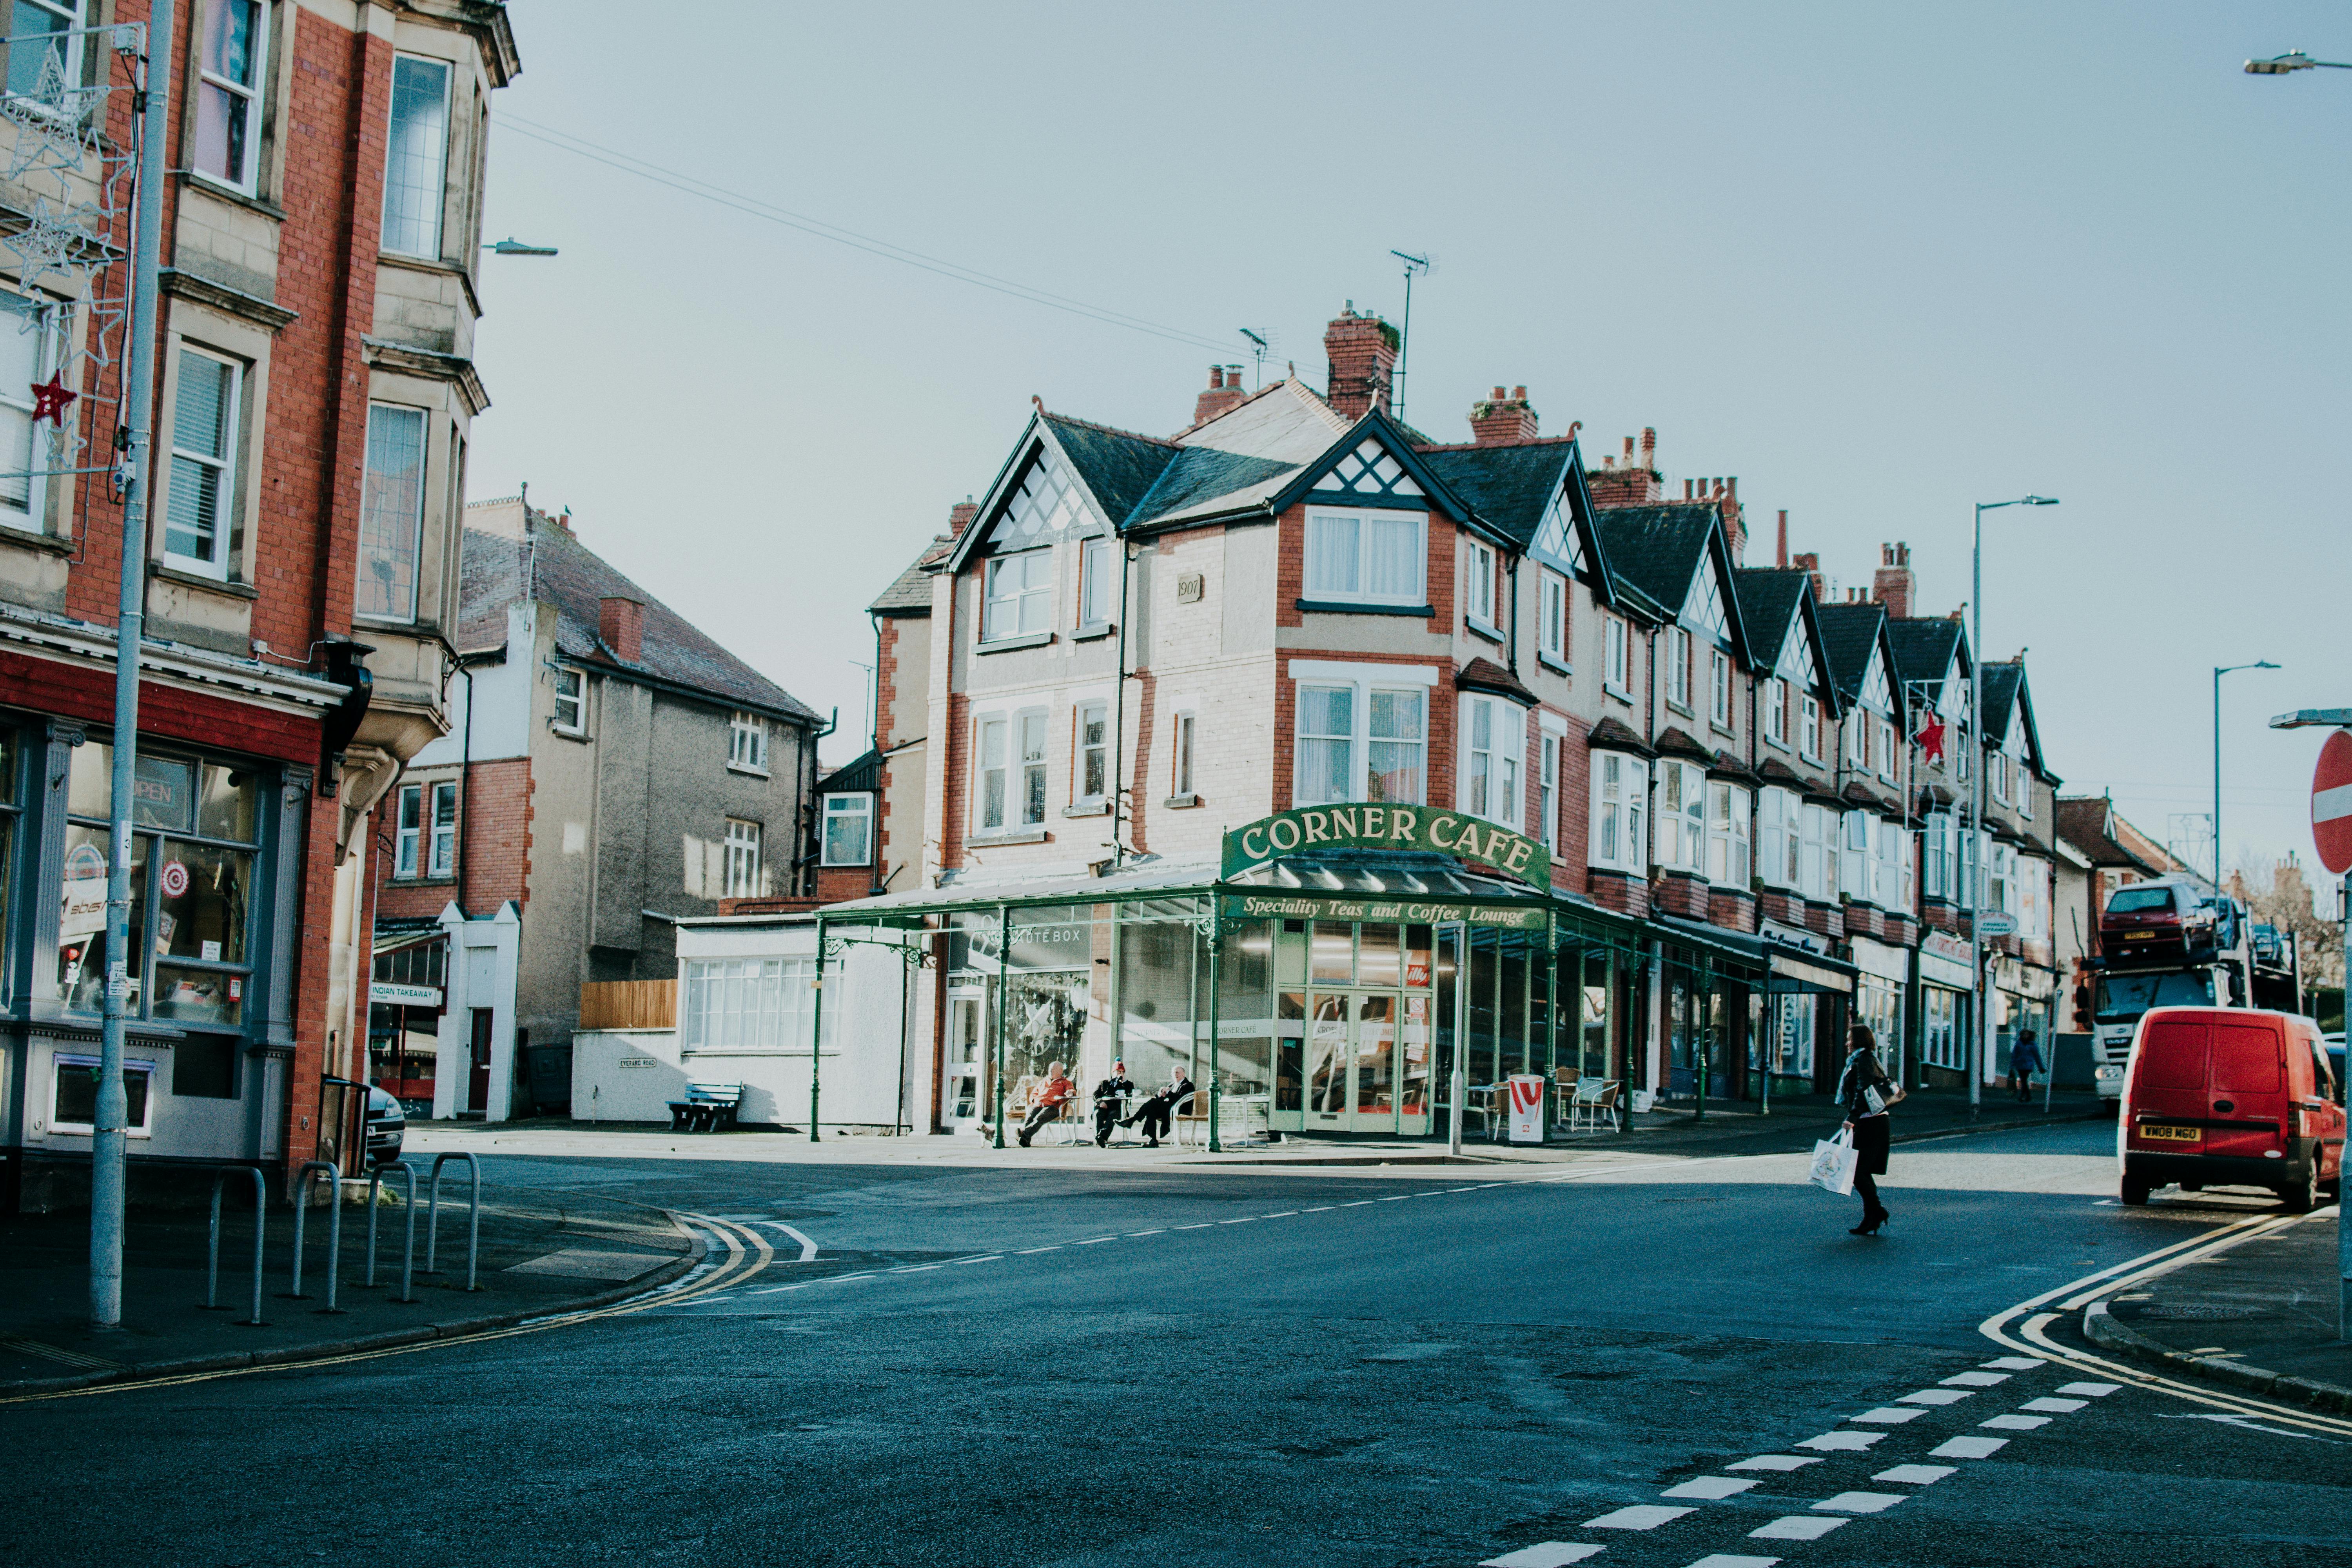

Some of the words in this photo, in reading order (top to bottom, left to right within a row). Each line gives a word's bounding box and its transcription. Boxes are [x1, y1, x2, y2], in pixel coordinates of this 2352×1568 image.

[1178, 580, 1198, 596] 1907
[1242, 808, 1416, 859] CORNER
[1429, 817, 1533, 873] CAFÉ
[1243, 897, 1320, 918] Speciality
[1329, 901, 1363, 916] Teas
[1371, 904, 1402, 918] and
[1408, 904, 1460, 923] Coffee
[1468, 906, 1525, 926] Lounge
[1053, 930, 1080, 942] BOX
[1408, 967, 1427, 984] illy
[372, 986, 395, 995] INDIAN
[397, 989, 432, 998] TAKEAWAY
[1217, 1026, 1240, 1034] ORNER
